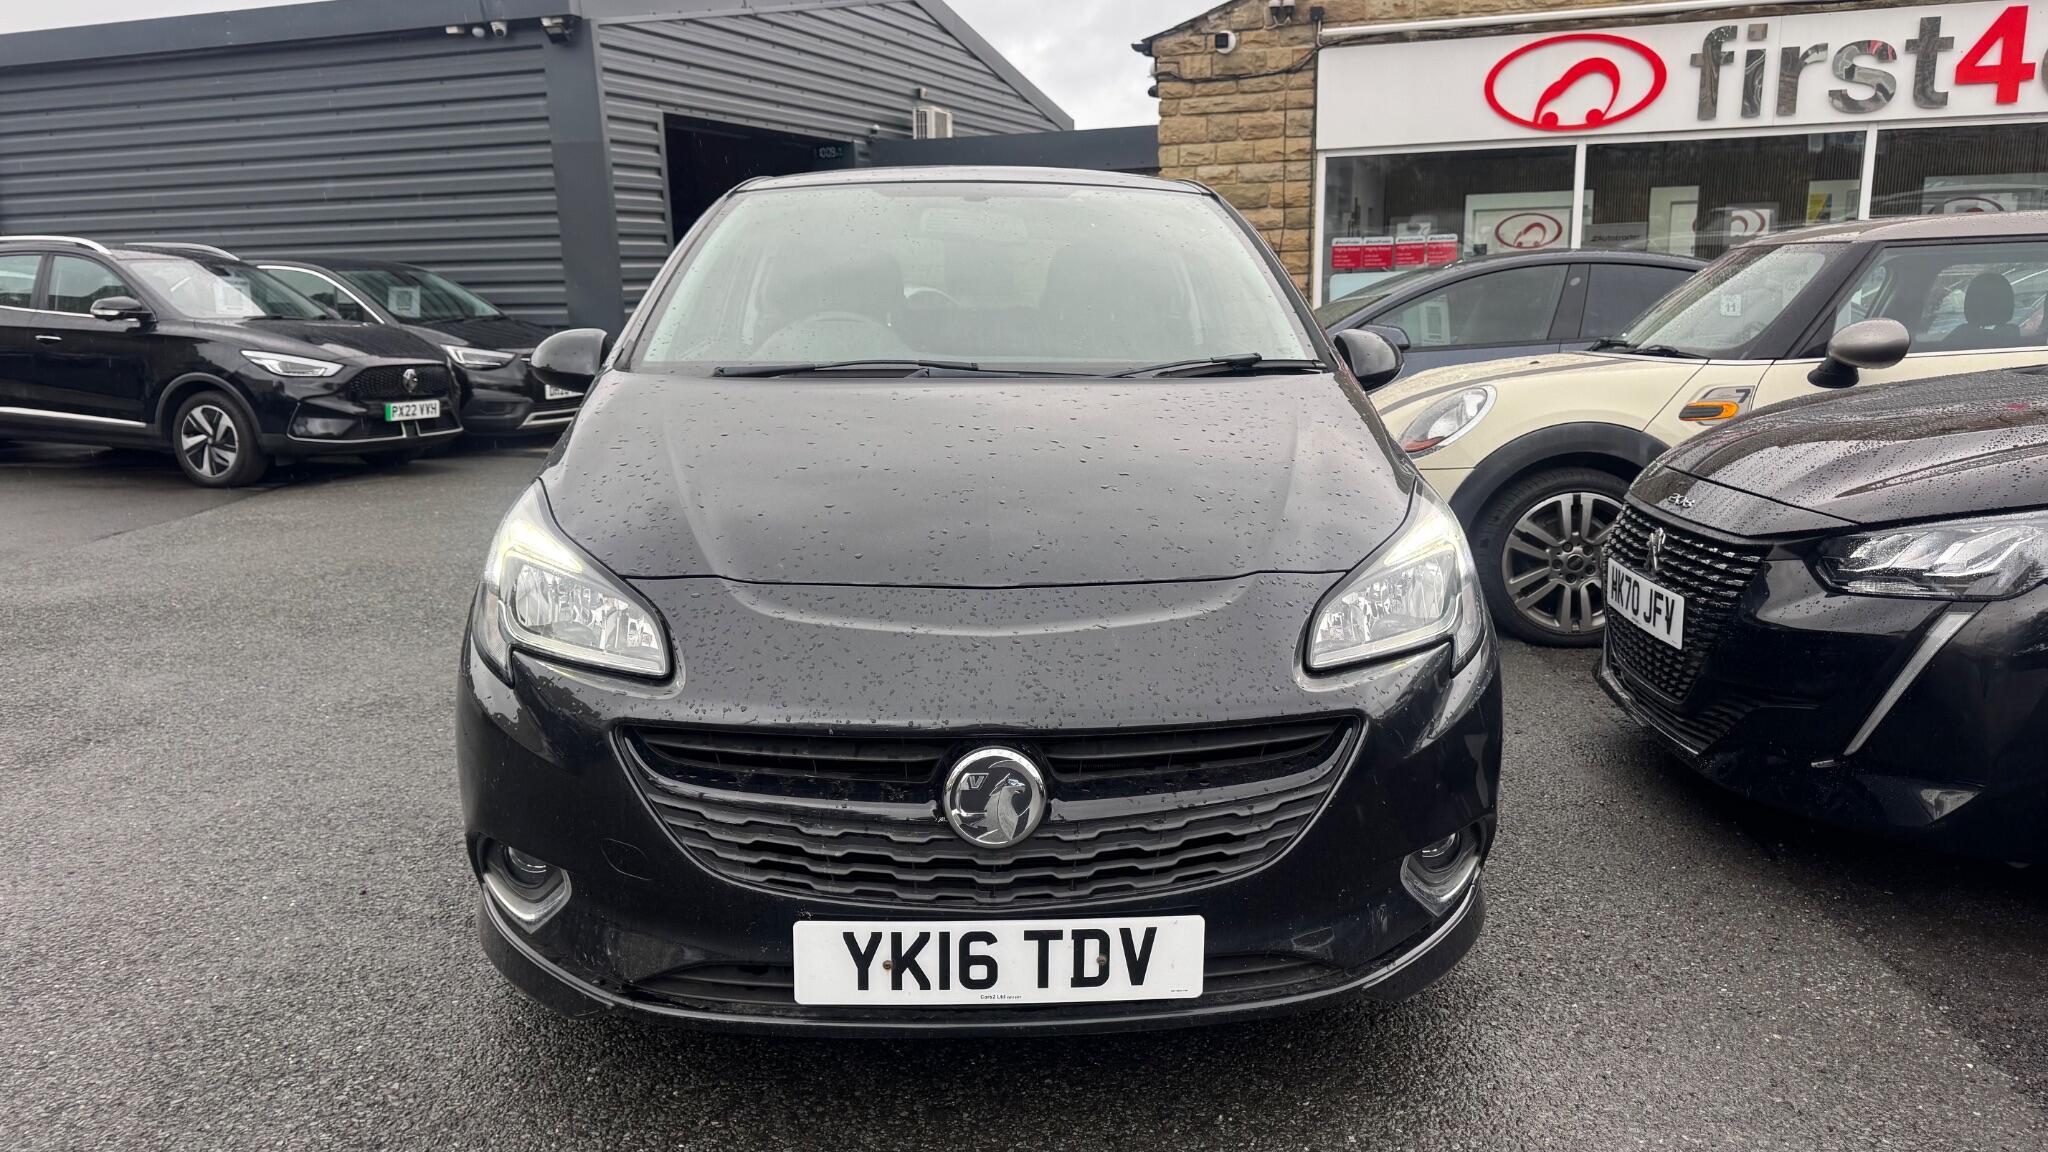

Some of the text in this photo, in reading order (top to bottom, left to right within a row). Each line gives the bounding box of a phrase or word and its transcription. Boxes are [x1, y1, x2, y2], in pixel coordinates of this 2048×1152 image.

[1690, 5, 2048, 121] first4
[1611, 565, 1675, 635] HK70 JFV
[842, 926, 1158, 991] YK16 TDV
